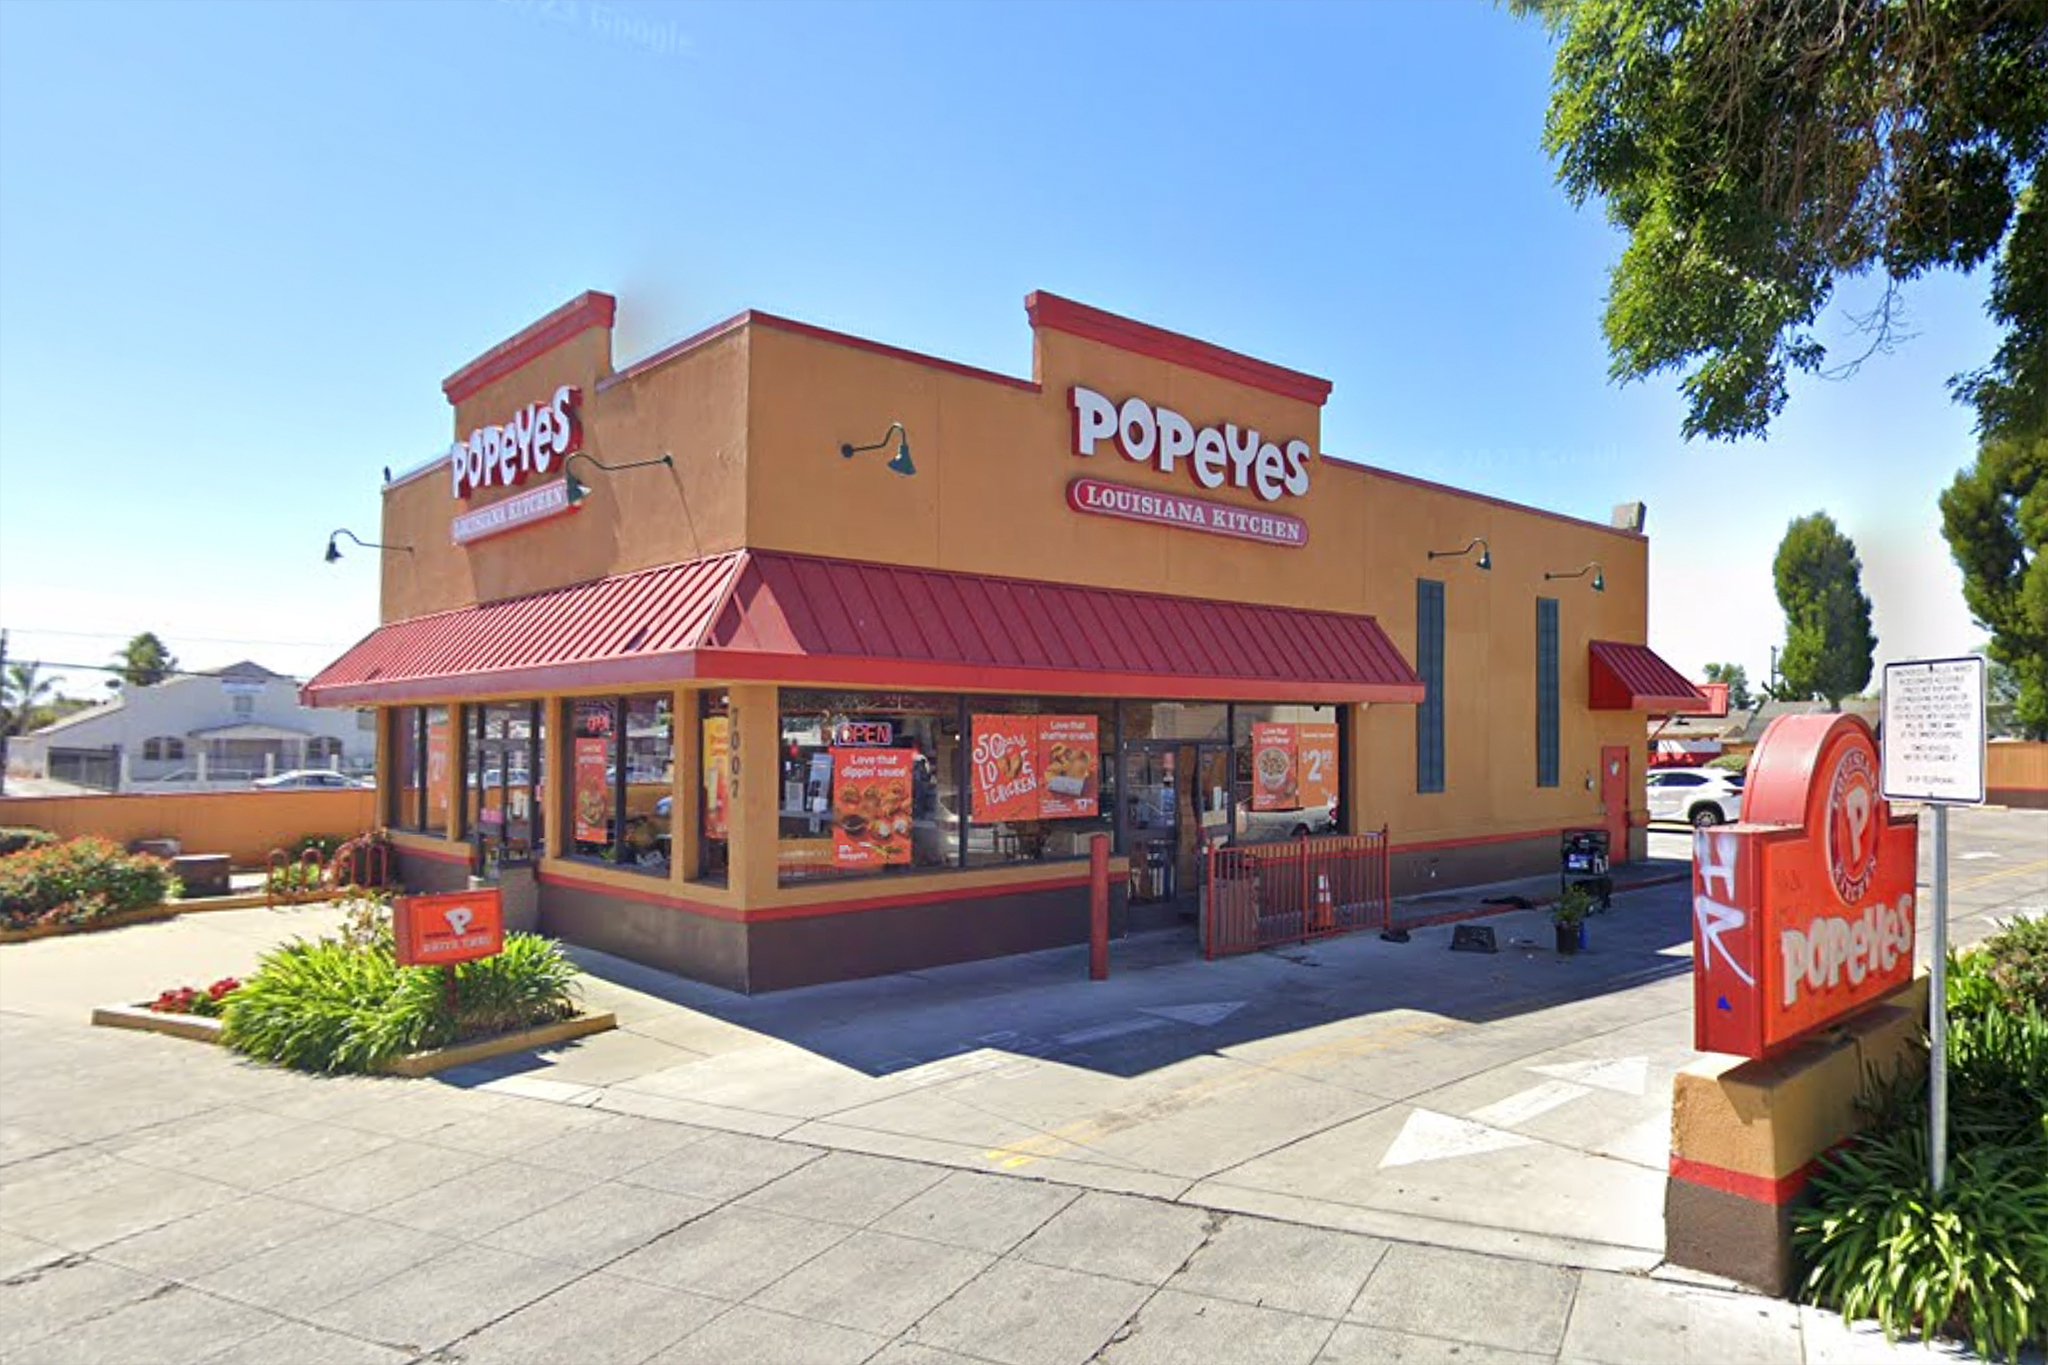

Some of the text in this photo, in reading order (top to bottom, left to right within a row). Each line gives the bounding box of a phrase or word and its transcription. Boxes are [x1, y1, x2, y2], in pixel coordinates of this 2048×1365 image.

[1087, 486, 1300, 541] LOUISIANA KITCHEN
[841, 723, 890, 742] OPEN
[850, 754, 897, 765] Love that
